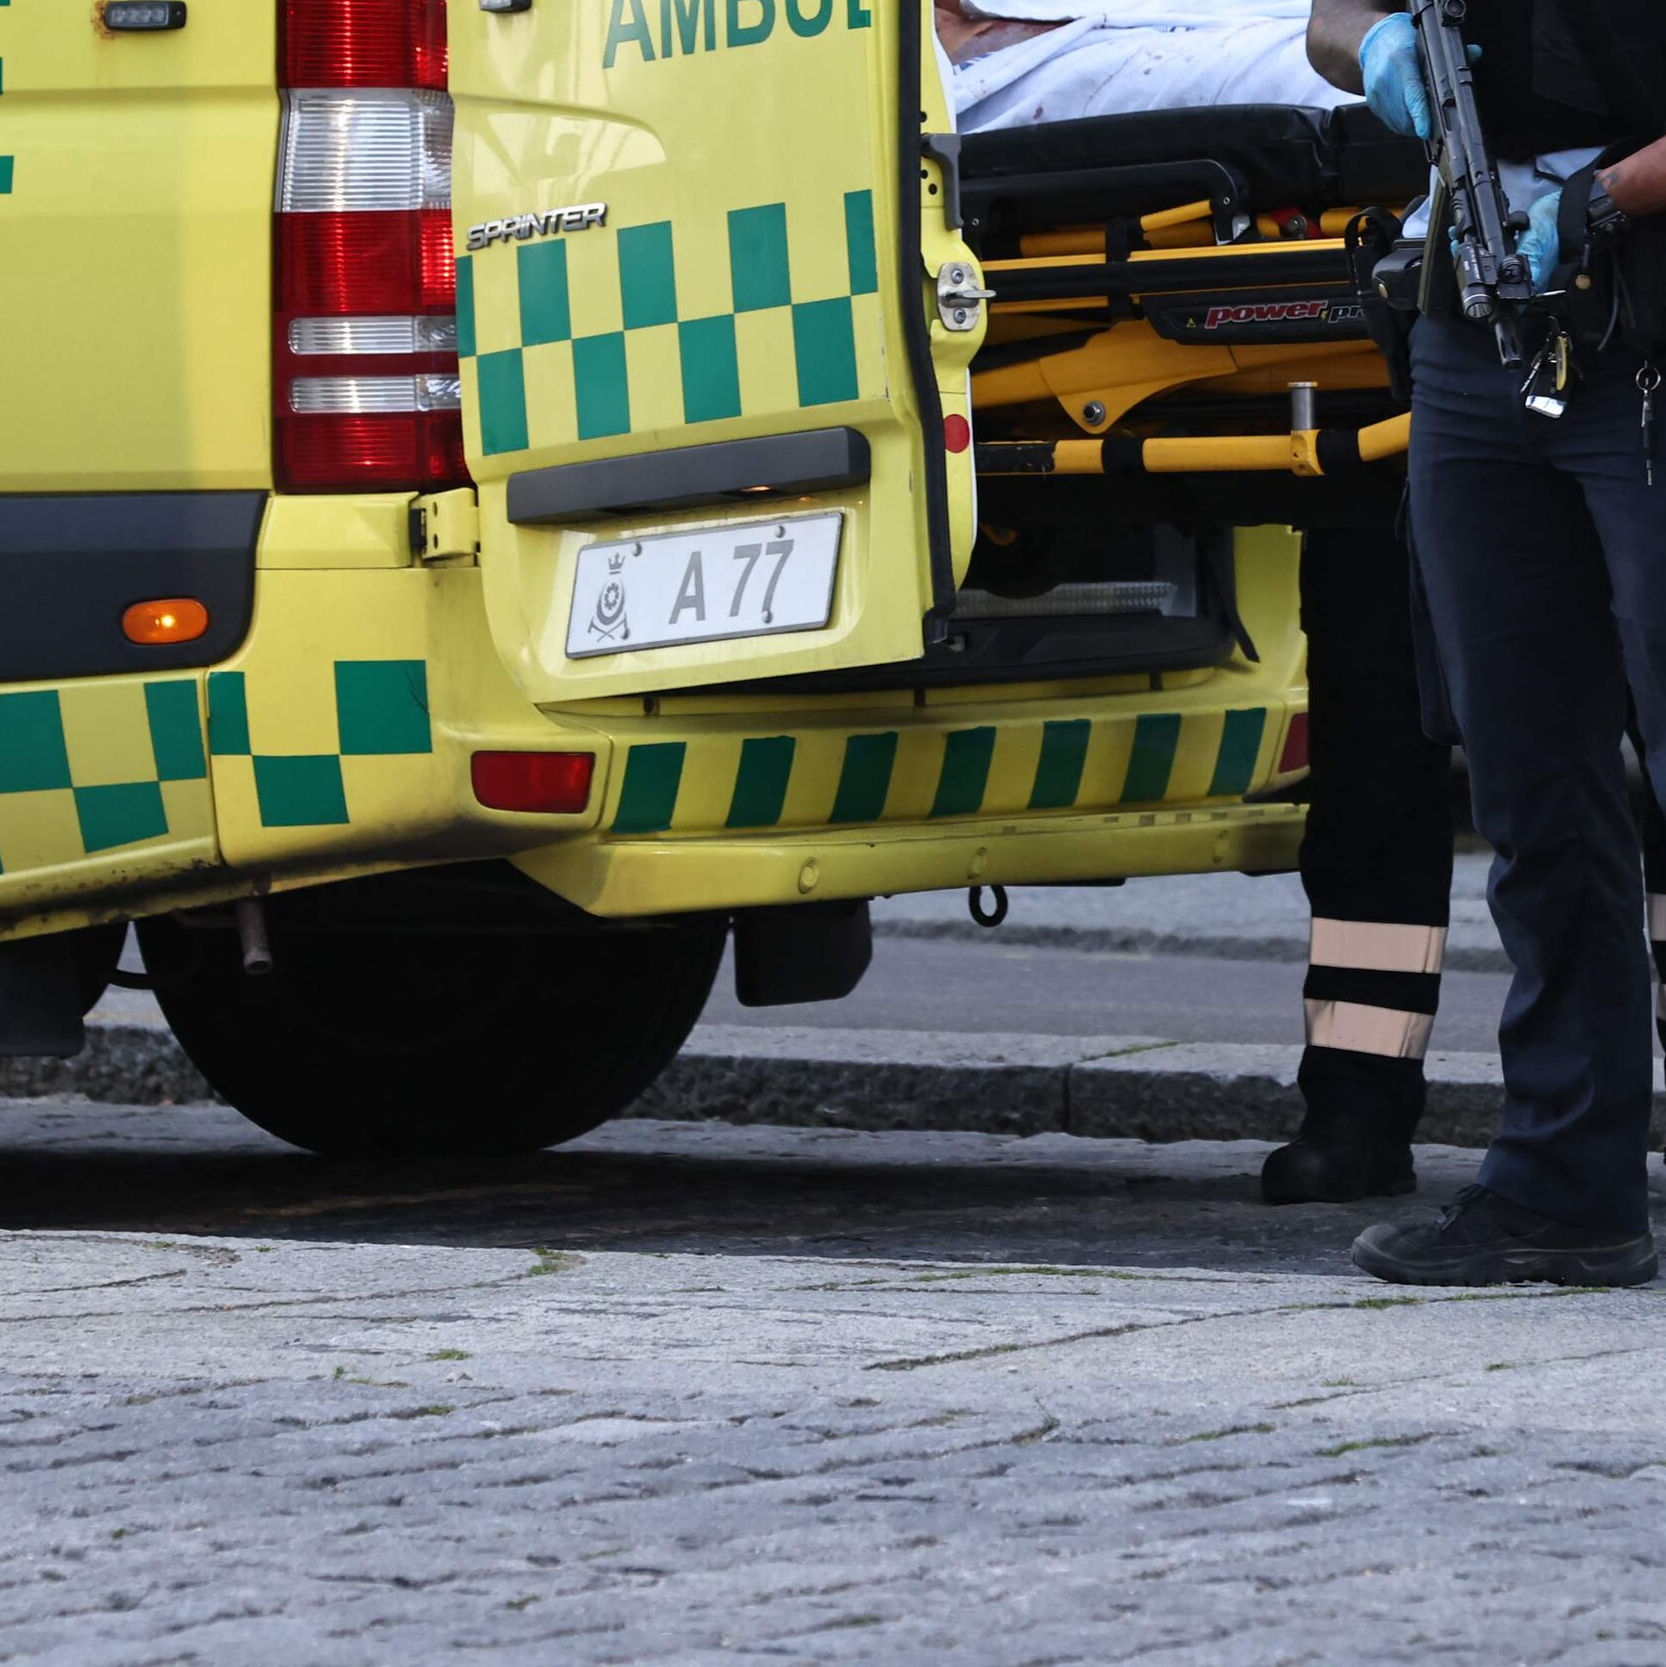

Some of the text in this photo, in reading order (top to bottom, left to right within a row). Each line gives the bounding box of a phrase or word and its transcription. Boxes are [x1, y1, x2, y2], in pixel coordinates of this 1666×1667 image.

[467, 202, 607, 251] SPRINTER
[1205, 300, 1329, 329] power
[668, 539, 795, 625] A 77
